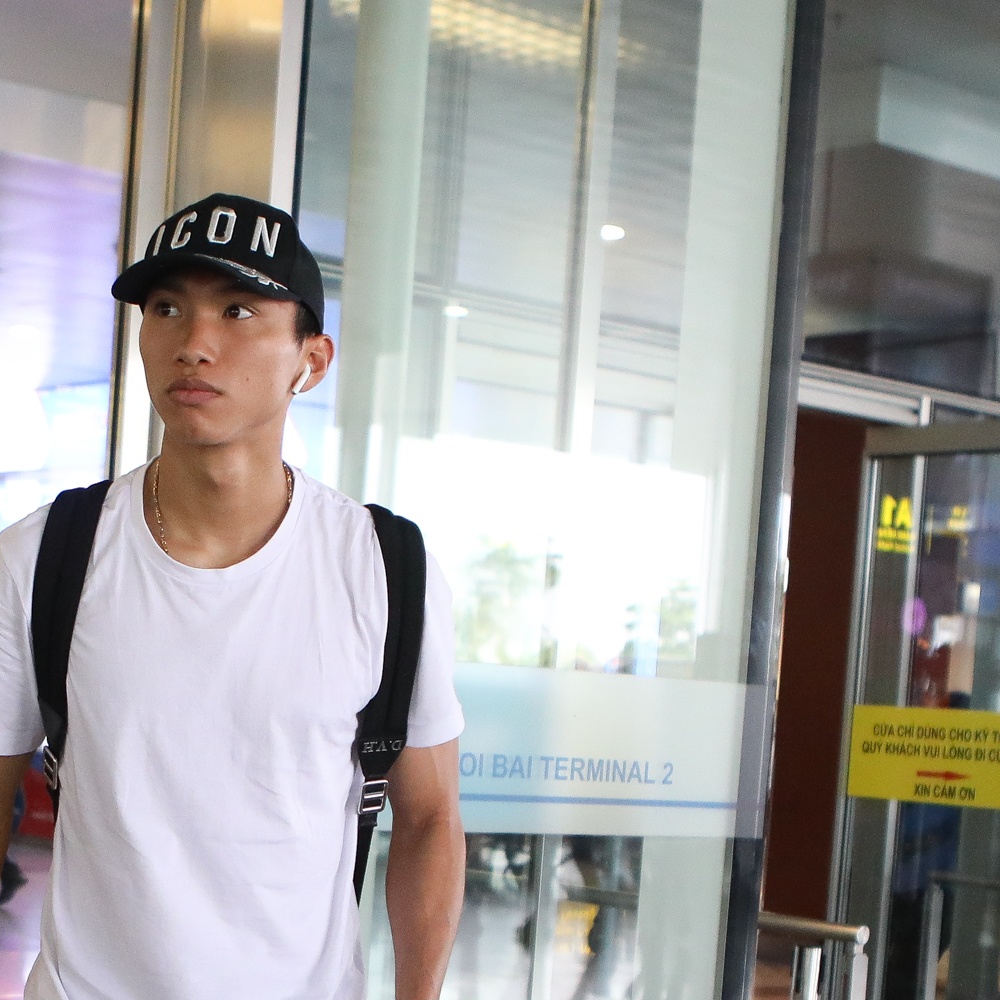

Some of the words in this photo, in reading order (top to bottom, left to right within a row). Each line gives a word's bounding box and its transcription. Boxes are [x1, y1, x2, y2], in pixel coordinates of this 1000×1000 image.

[152, 206, 281, 258] ICON
[949, 728, 972, 742] CHO
[459, 752, 484, 777] OI
[492, 753, 532, 779] BAI
[540, 756, 655, 784] TERMINAL
[661, 762, 674, 785] 2
[914, 783, 931, 796] XIN
